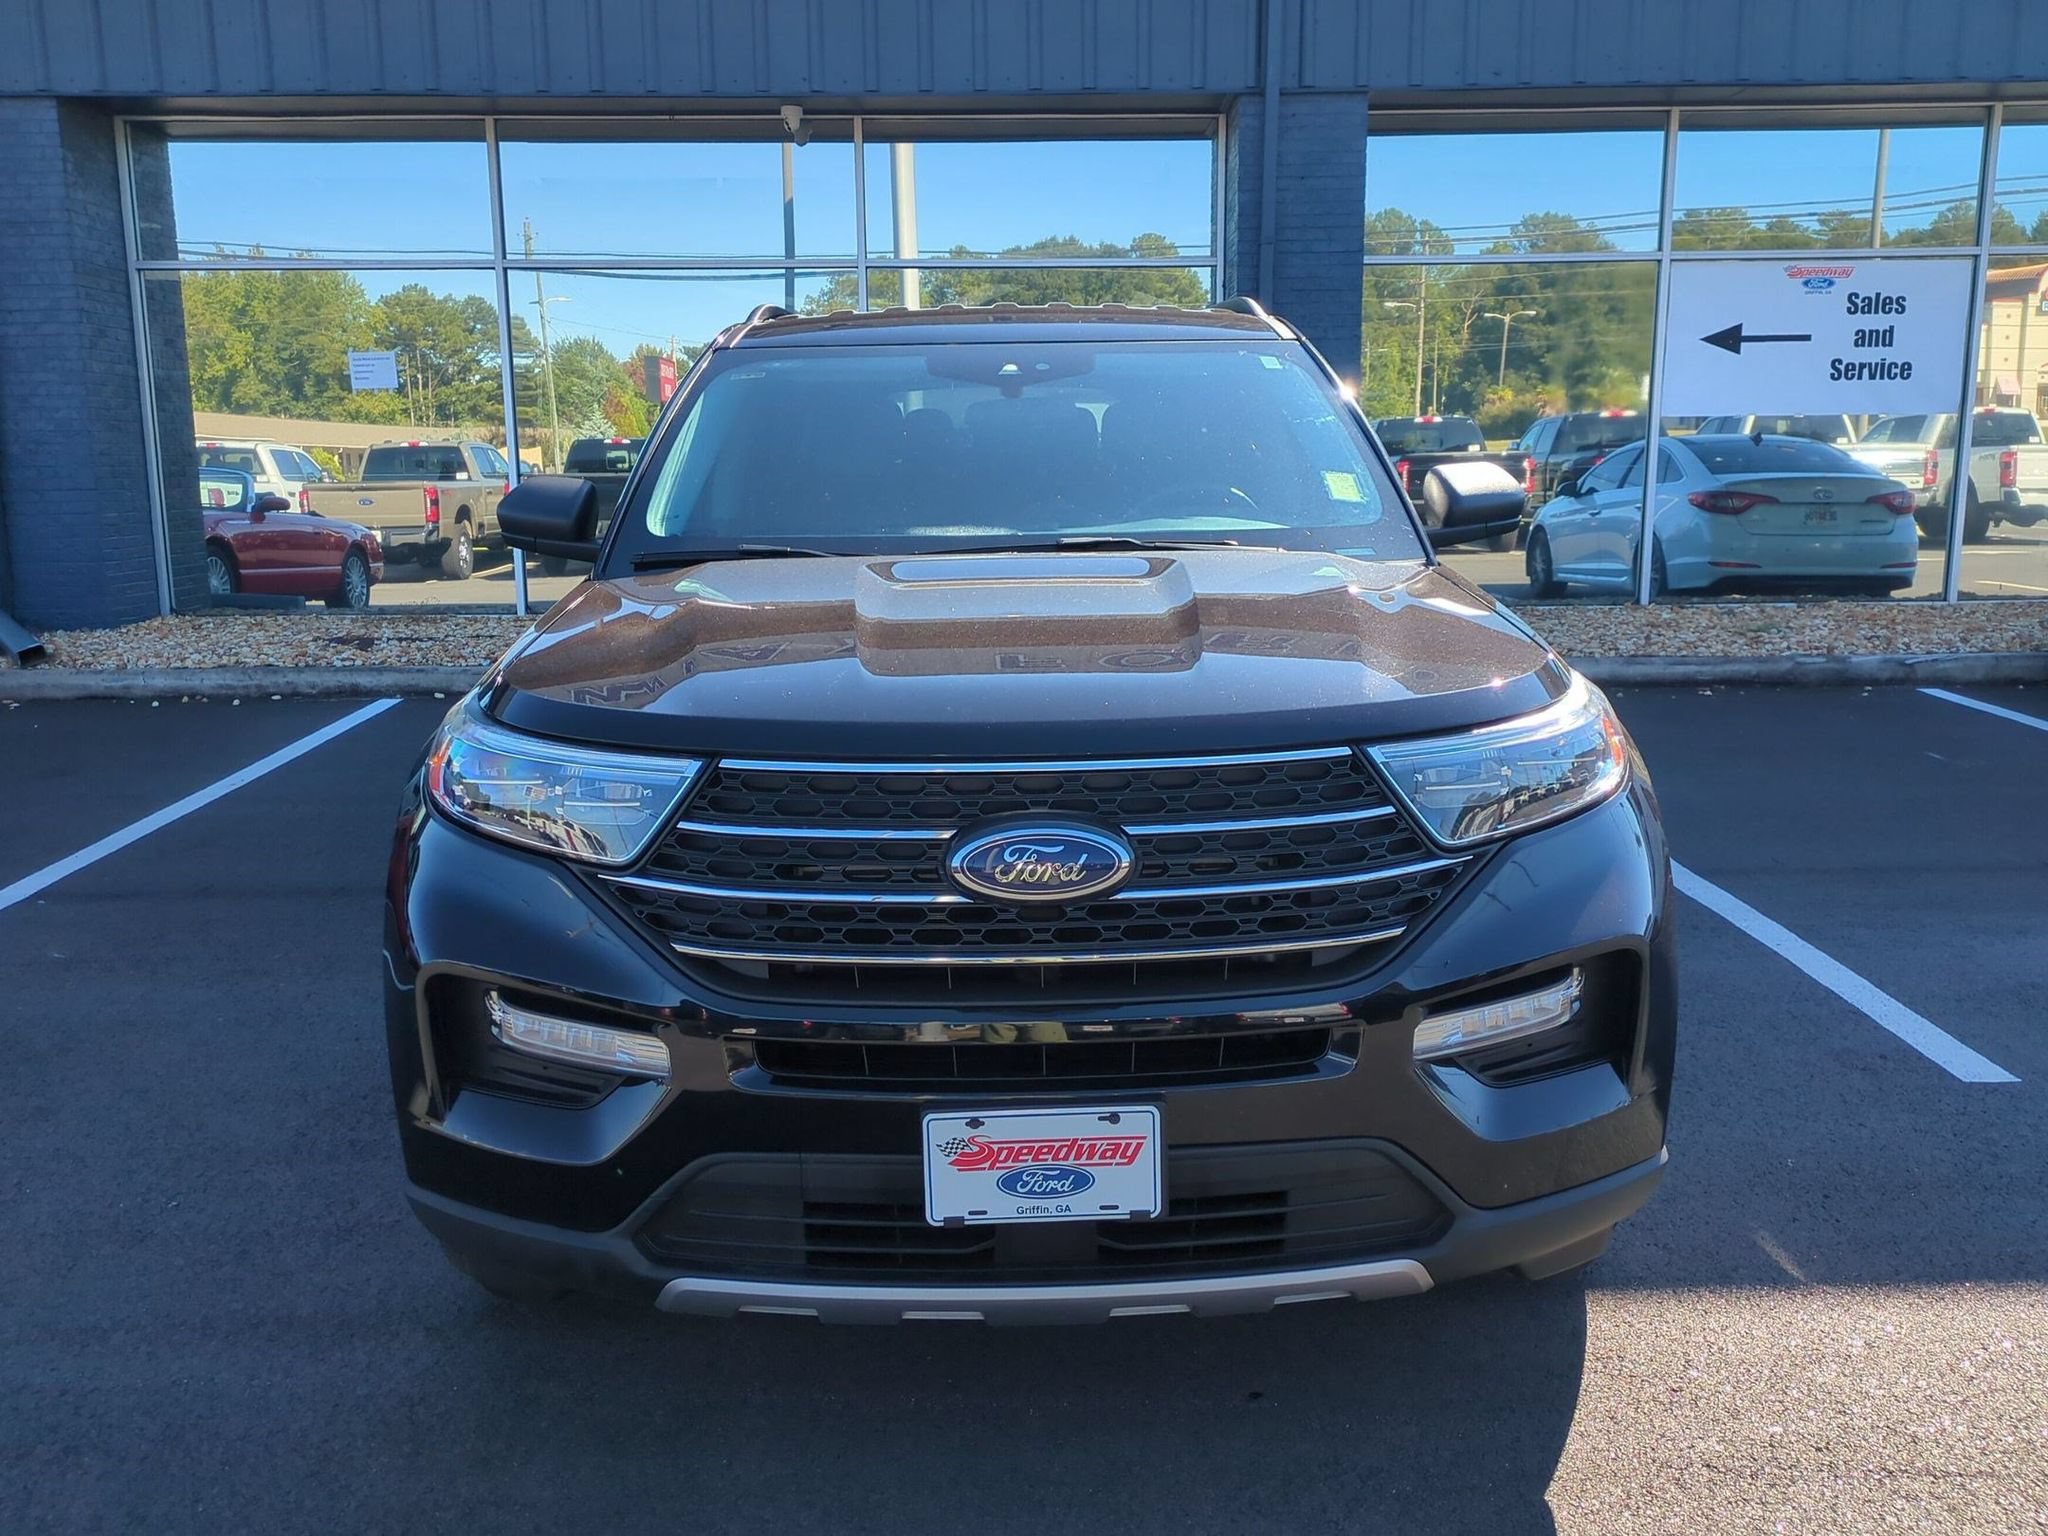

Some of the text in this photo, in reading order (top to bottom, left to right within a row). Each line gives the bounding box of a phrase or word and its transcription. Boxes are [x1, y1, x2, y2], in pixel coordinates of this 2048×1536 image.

[1787, 265, 1855, 279] Speedway
[1846, 291, 1907, 316] Sales
[1853, 325, 1895, 348] and
[1829, 357, 1913, 381] Service
[994, 844, 1088, 883] Ford
[948, 1135, 1147, 1171] Speedway
[1016, 1169, 1075, 1193] Ford
[1016, 1204, 1072, 1215] Griffin, GA
